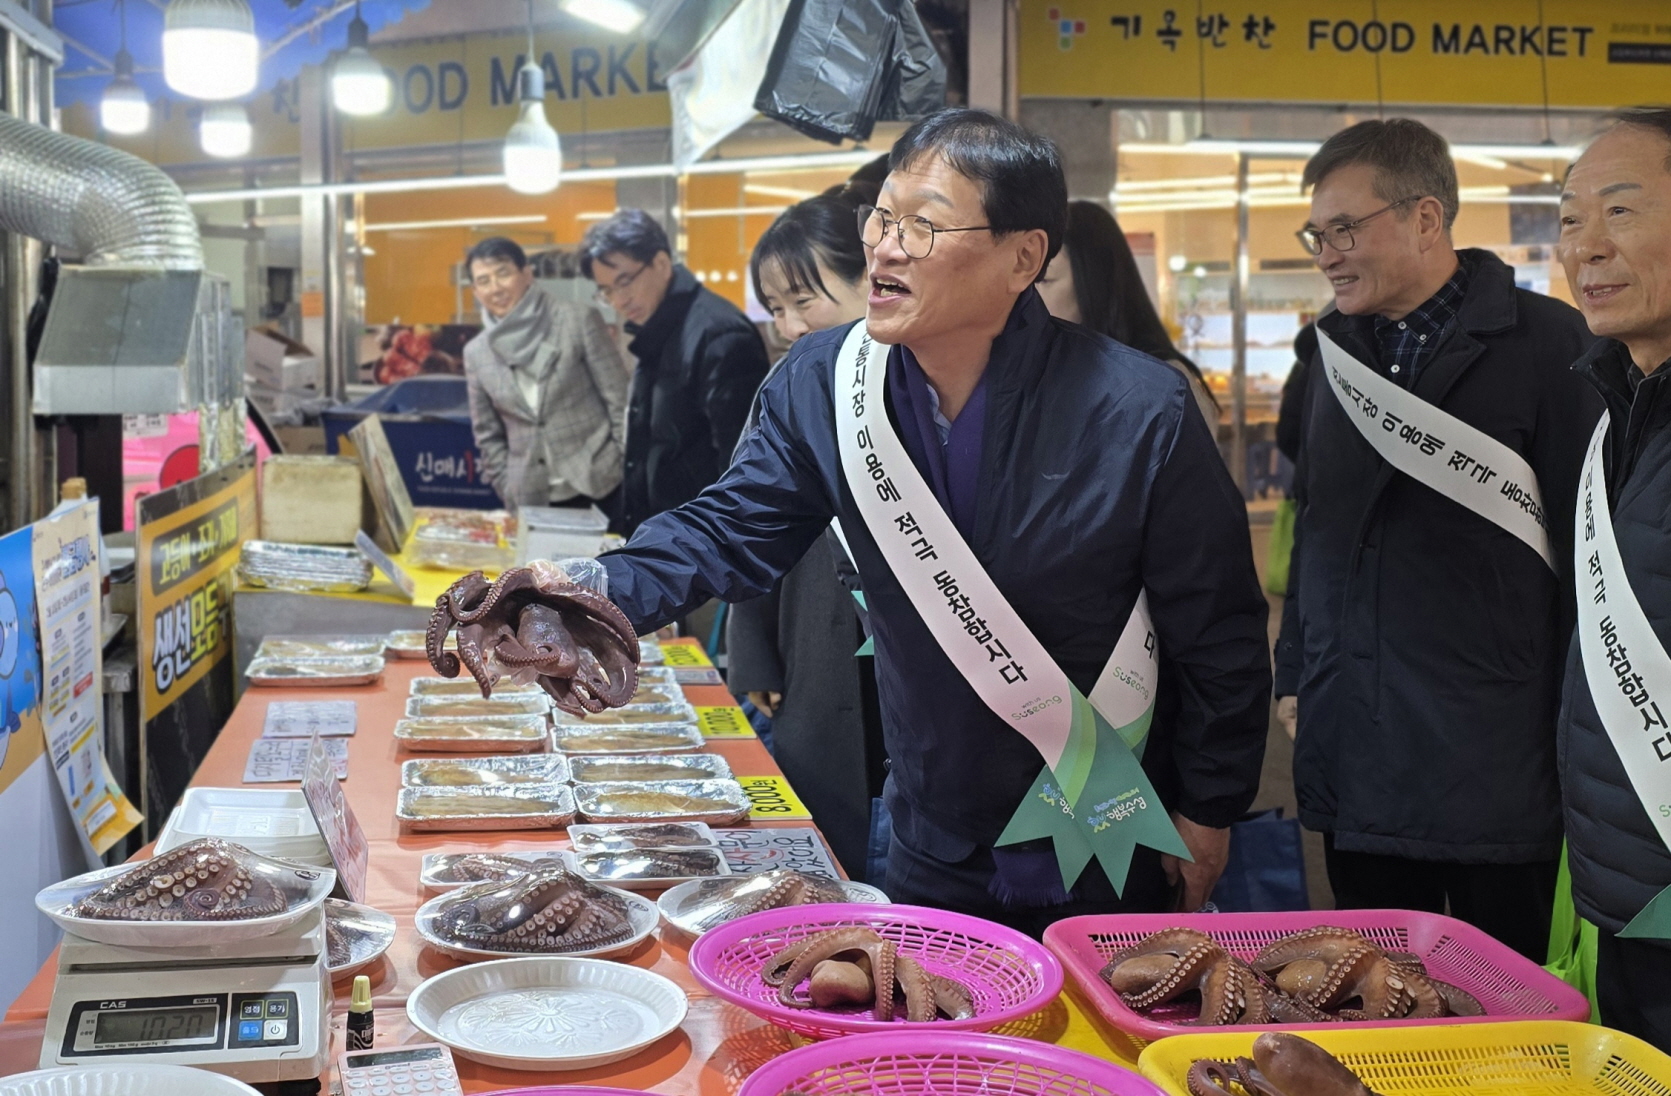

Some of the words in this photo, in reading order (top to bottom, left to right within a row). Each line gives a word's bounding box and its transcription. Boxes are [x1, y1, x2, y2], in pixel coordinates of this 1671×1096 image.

[1307, 19, 1415, 54] FOOD
[1431, 23, 1594, 57] MARKET
[489, 43, 668, 108] MARKE
[1381, 410, 1446, 457] 이용에
[1447, 450, 1498, 485] 적극
[856, 424, 902, 504] 이용에
[893, 511, 938, 562] 적극
[932, 569, 1029, 685] 동참합시다
[1586, 553, 1608, 606] 적극
[1112, 665, 1150, 701] Suseong
[1011, 694, 1063, 721] Suseong
[742, 778, 793, 813] 8,000원
[1106, 796, 1147, 822] 행복수성
[99, 1001, 126, 1010] CAS
[269, 1003, 286, 1014] 용기
